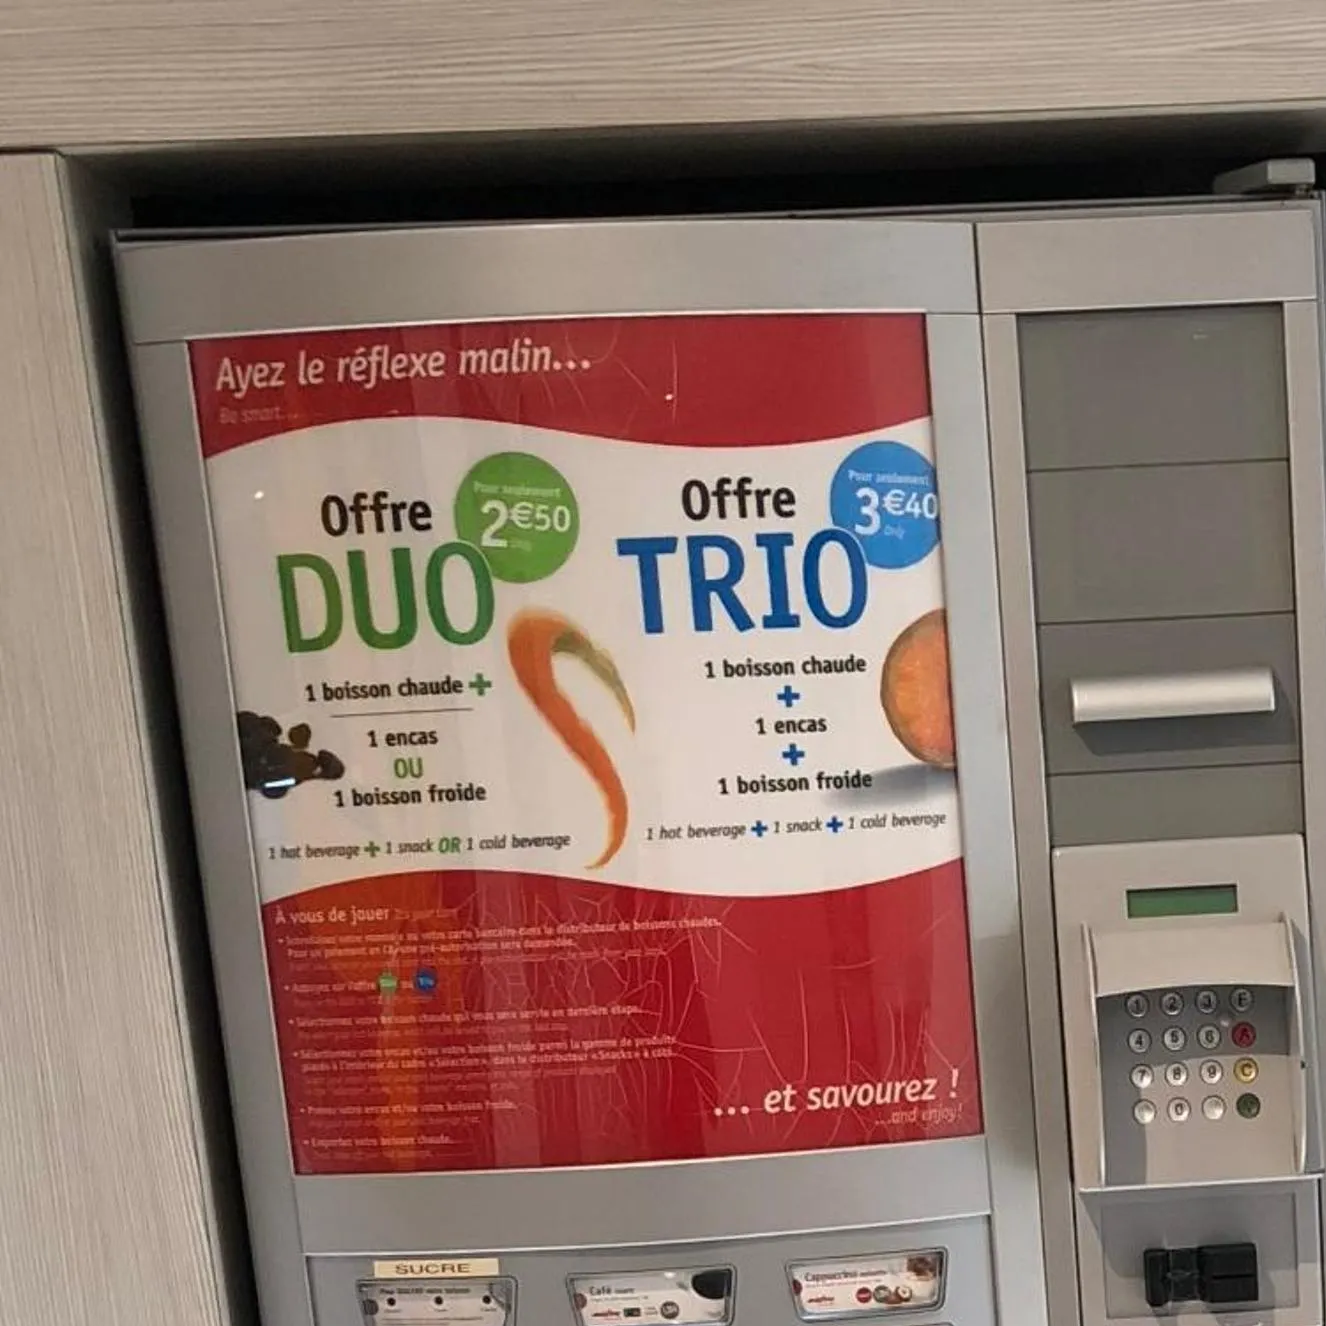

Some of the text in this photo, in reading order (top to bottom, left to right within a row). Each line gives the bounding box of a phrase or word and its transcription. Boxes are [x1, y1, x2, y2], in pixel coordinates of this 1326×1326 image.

[215, 338, 592, 398] Ayez le réflexe malin...
[681, 477, 796, 521] Offre
[854, 486, 938, 536] 3€40
[320, 491, 432, 536] Offre
[480, 500, 571, 549] 2€50
[616, 527, 868, 635] TRIO
[277, 541, 495, 653] DUO
[705, 654, 867, 679] 1 boisson chaude
[305, 675, 463, 702] 1 boisson chaude
[367, 729, 438, 748] 1 encas
[756, 716, 828, 734] 1 encas
[393, 757, 424, 778] OU
[334, 783, 487, 808] 1 boisson froide
[718, 770, 873, 795] 1 boisson froide
[646, 812, 947, 841] 1 hot beverage 1 snack 1 cold beverage
[268, 833, 571, 862] 1 hot beverage 1 snack OR 1 cold beverage
[290, 909, 324, 924] vous
[327, 908, 347, 923] de
[350, 906, 390, 926] jouer
[1241, 1063, 1253, 1077] C
[763, 1084, 797, 1114] et
[807, 1077, 938, 1110] savourez
[394, 1262, 471, 1275] SUCRE
